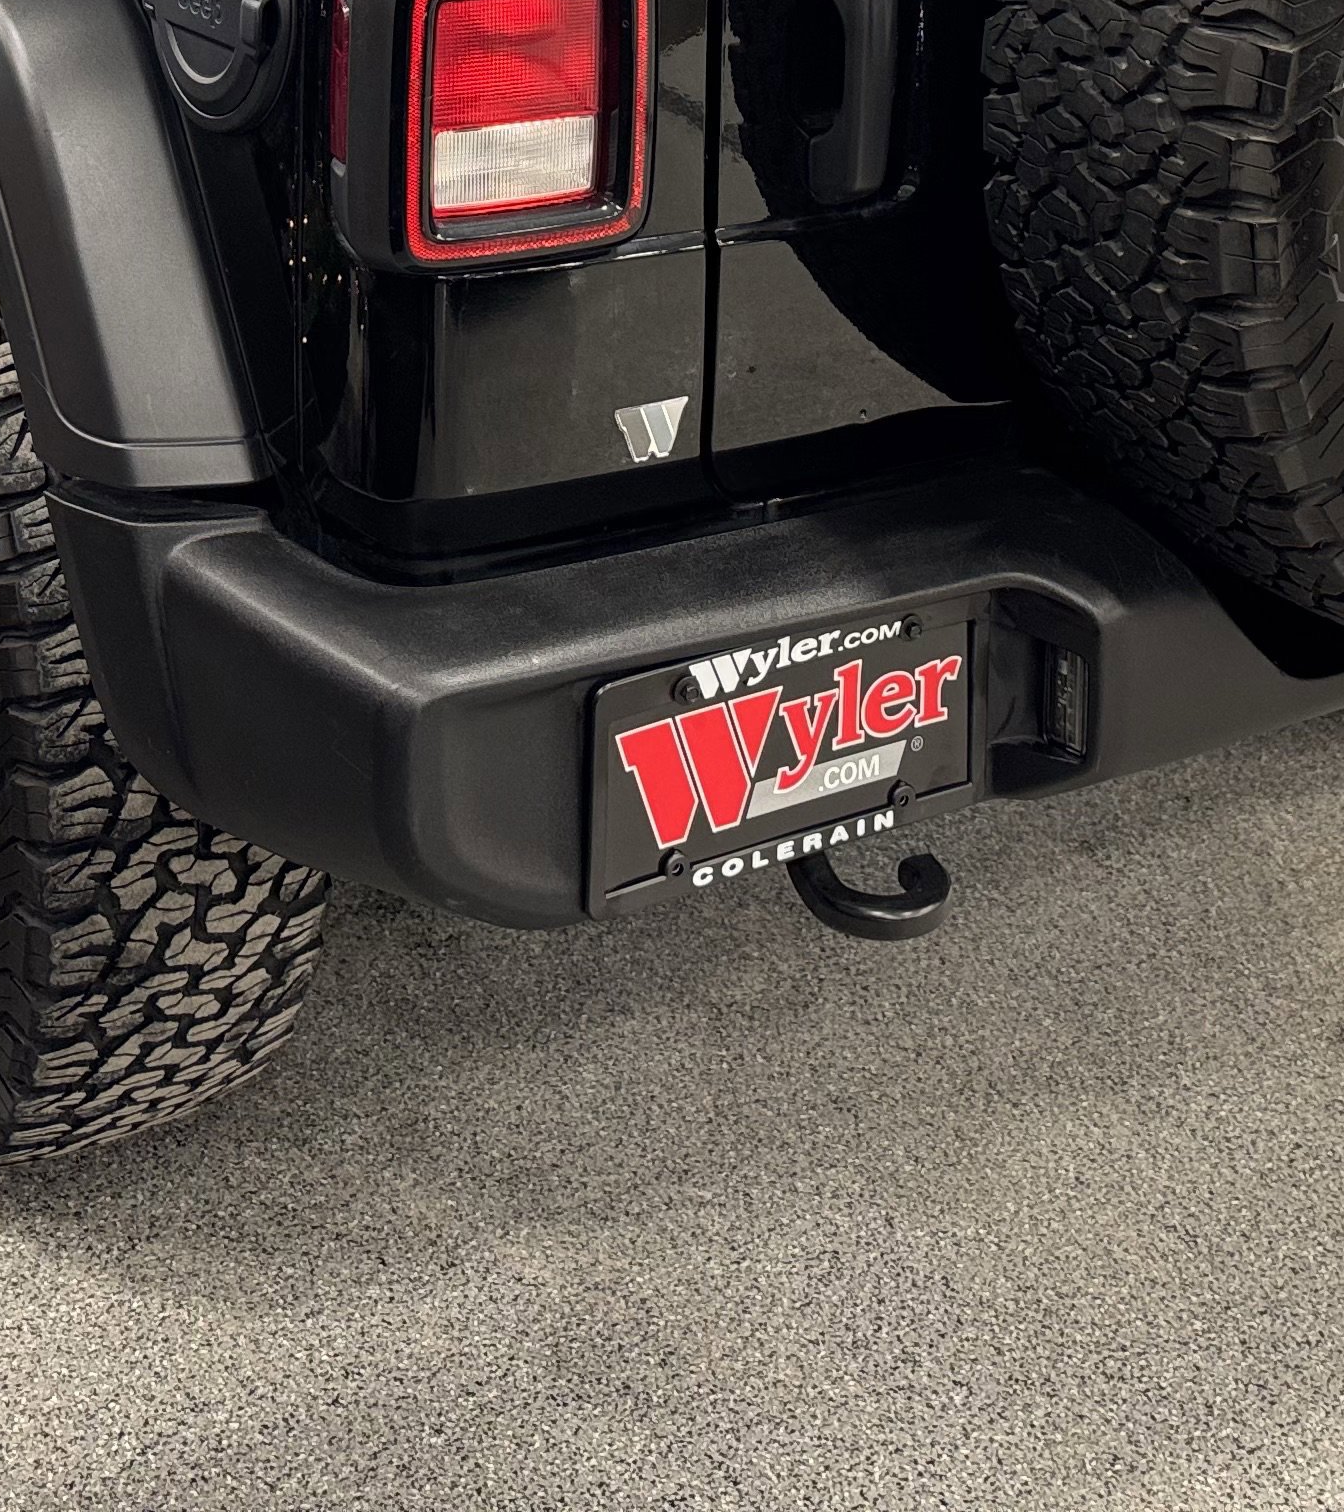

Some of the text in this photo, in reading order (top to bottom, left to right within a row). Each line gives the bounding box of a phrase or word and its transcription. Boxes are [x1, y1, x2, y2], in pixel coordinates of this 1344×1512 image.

[615, 655, 963, 849] Wyler
[818, 754, 880, 792] .COM
[692, 810, 895, 887] COLERAIN
